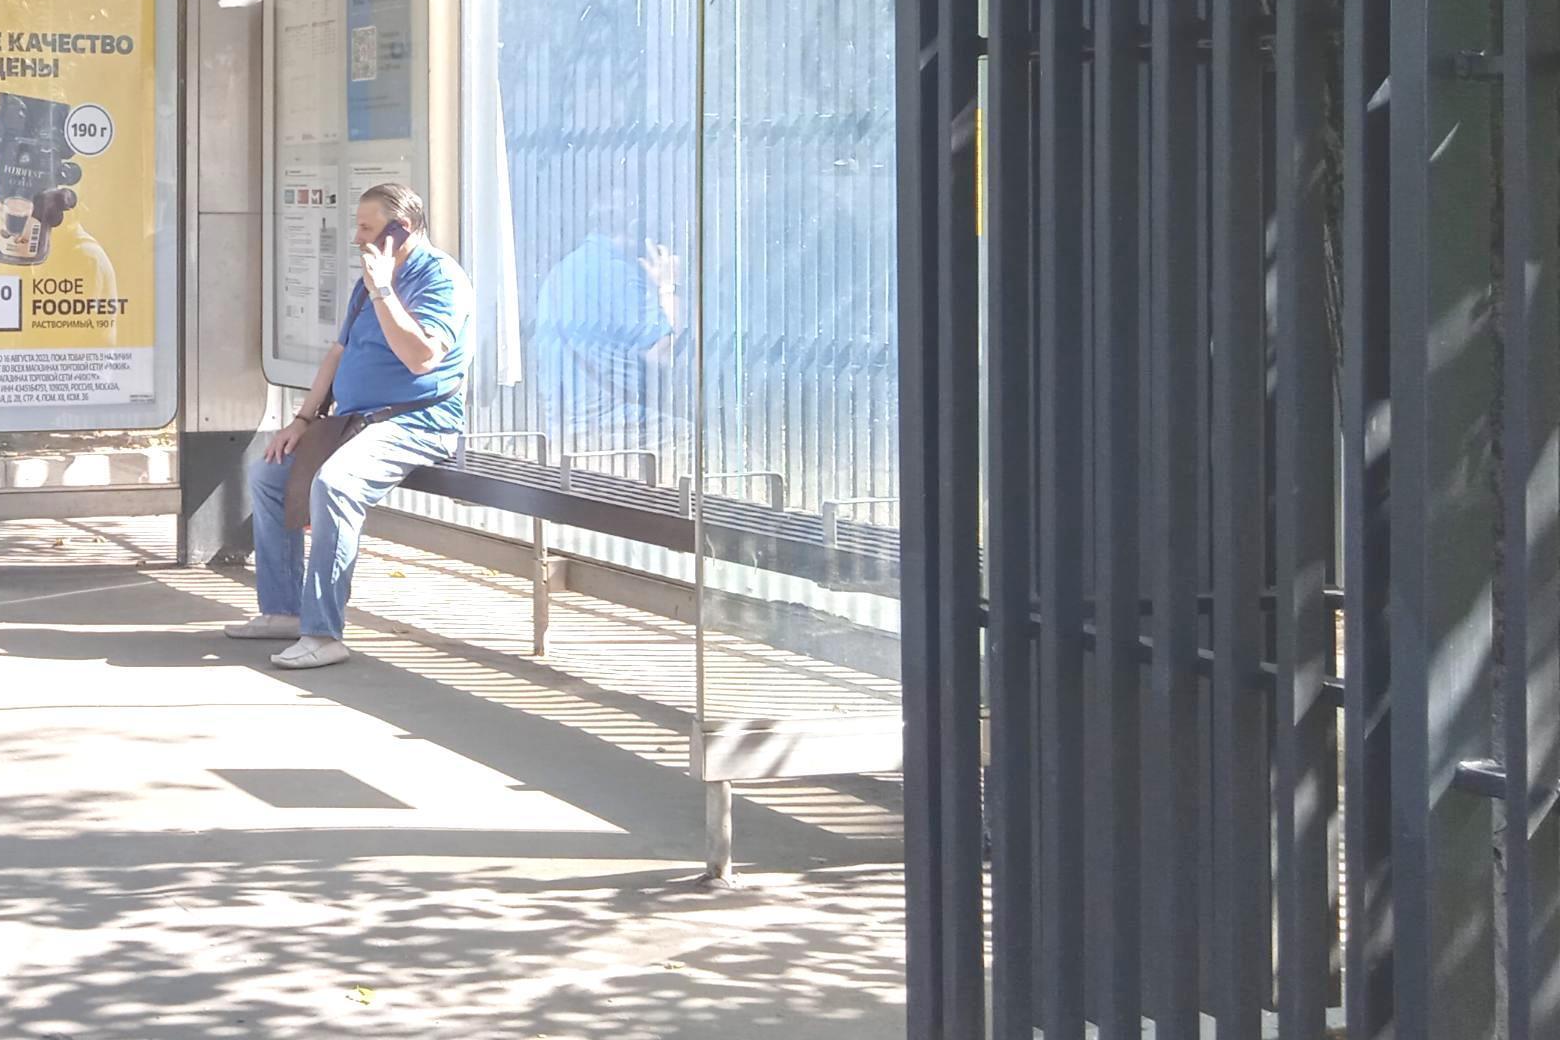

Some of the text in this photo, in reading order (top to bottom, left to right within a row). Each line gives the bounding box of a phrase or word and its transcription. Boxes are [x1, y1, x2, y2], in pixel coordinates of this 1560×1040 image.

[8, 32, 134, 55] КАЧЕСТВО
[71, 123, 97, 138] 190
[32, 278, 84, 295] КОФЕ
[32, 299, 129, 315] FOODFEST
[31, 319, 95, 329] РАСТВОРИМЫЙ,
[96, 320, 109, 328] 190
